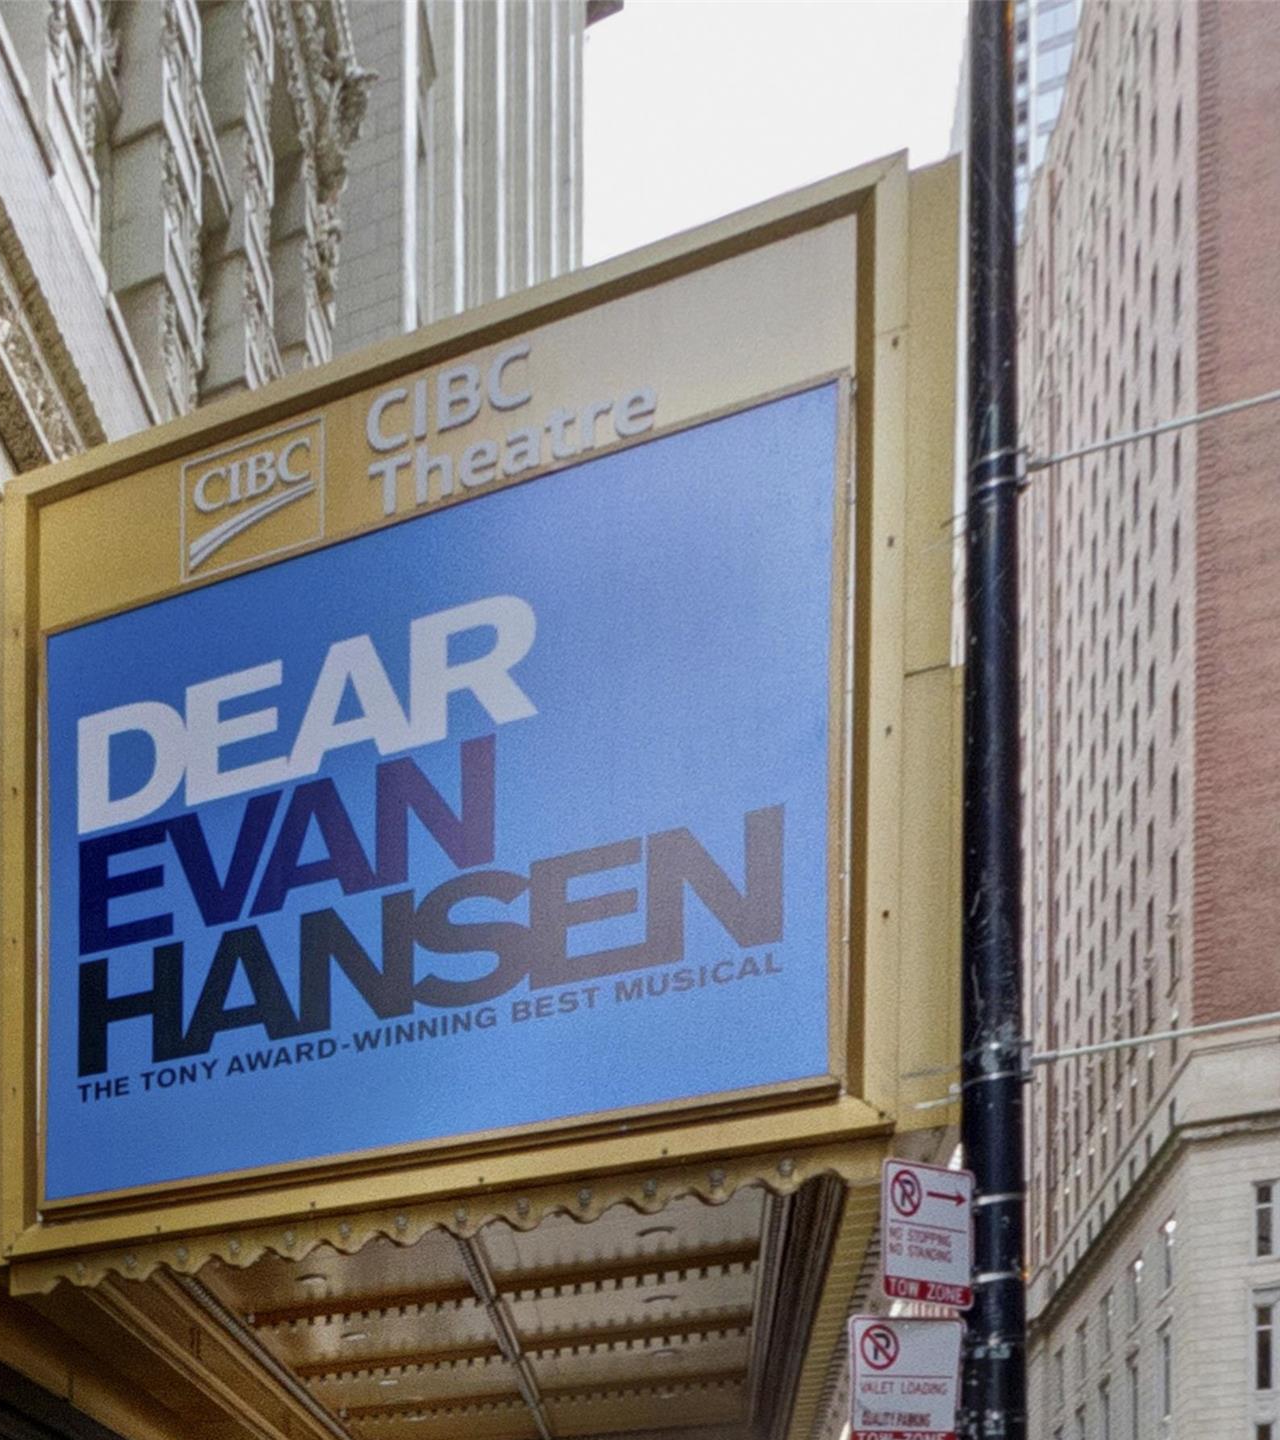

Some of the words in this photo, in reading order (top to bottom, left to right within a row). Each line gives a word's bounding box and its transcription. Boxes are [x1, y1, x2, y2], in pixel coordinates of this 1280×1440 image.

[367, 344, 533, 454] CIBC
[367, 383, 659, 516] Theatre
[193, 438, 312, 514] CIBC
[77, 595, 538, 835] DEAR
[78, 733, 497, 957] EVAN
[77, 804, 785, 1078] HANSEN
[77, 1072, 130, 1104] THE
[140, 1060, 218, 1095] TONY
[227, 1006, 498, 1076] AWARD-WINNING
[510, 986, 599, 1024] BEST
[614, 952, 784, 1004] MUSICAL
[889, 1277, 919, 1298] TOW
[927, 1282, 964, 1304] ZONE
